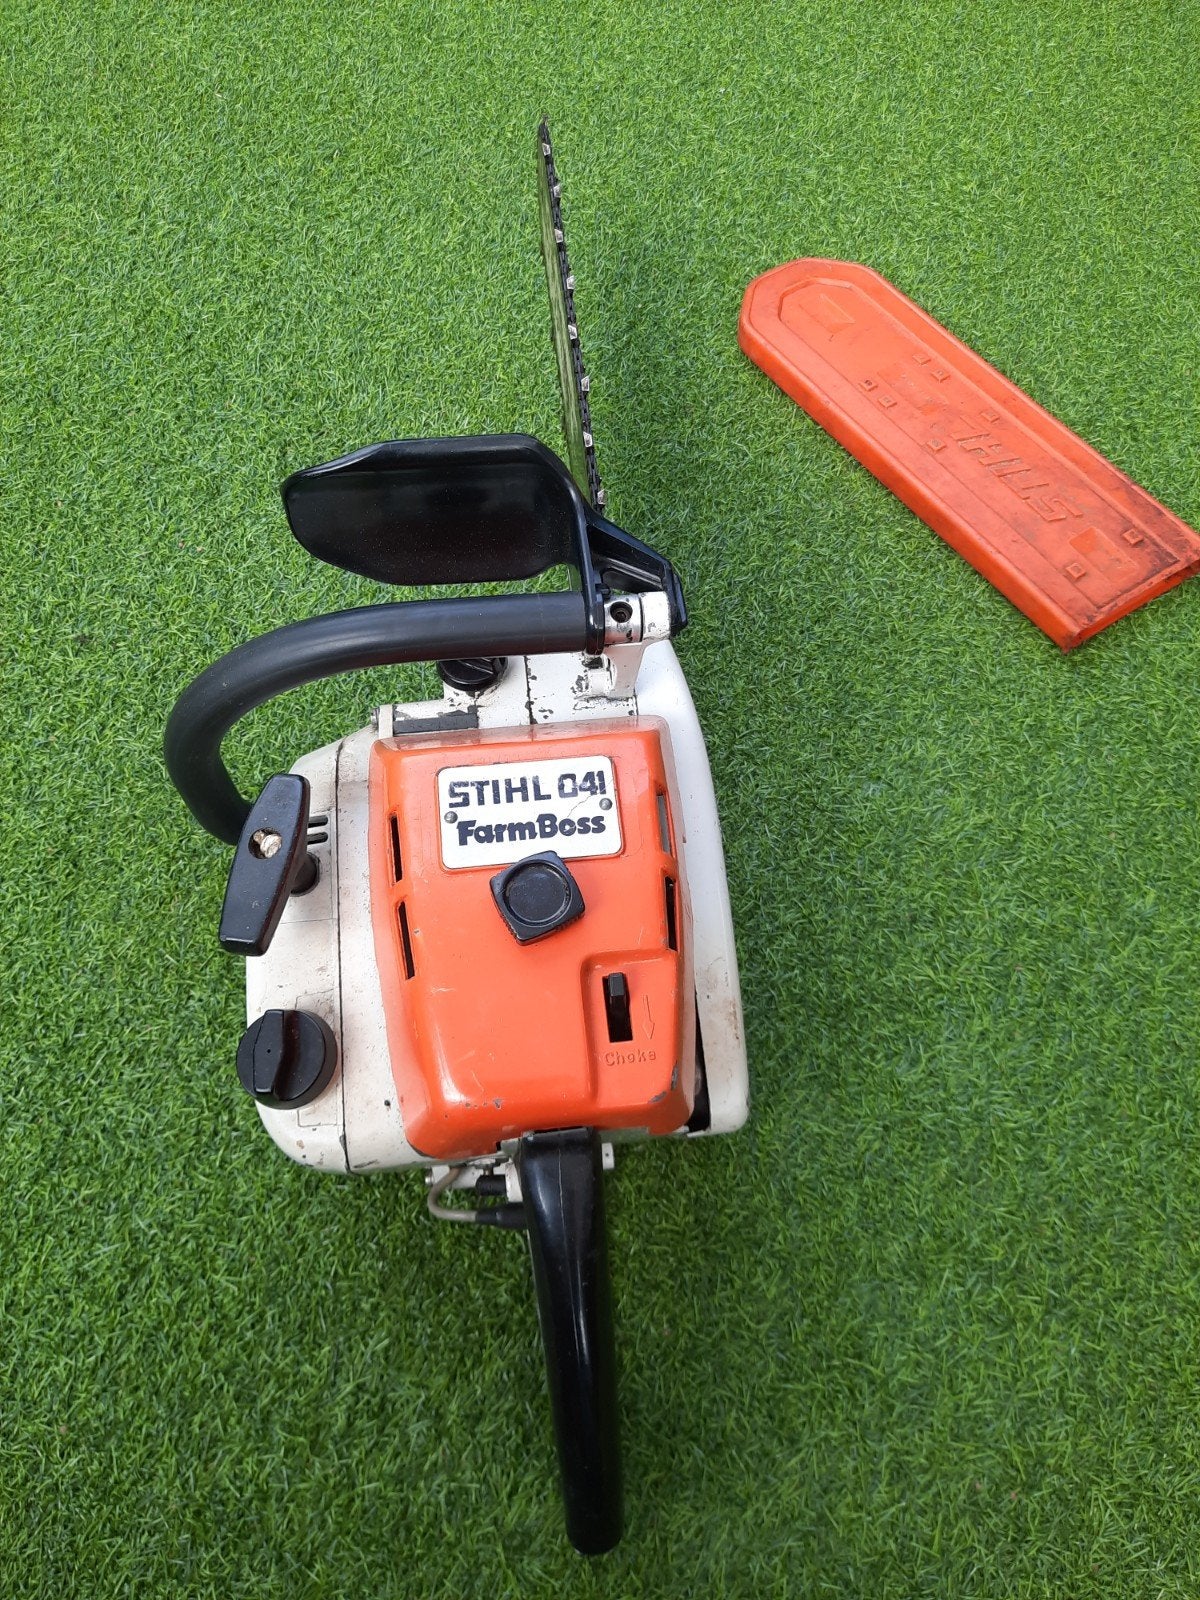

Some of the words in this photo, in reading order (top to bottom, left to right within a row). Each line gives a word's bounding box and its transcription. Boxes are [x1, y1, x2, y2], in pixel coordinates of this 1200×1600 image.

[949, 413, 1083, 522] STIHL
[448, 775, 551, 808] STIHL
[558, 770, 607, 798] 041
